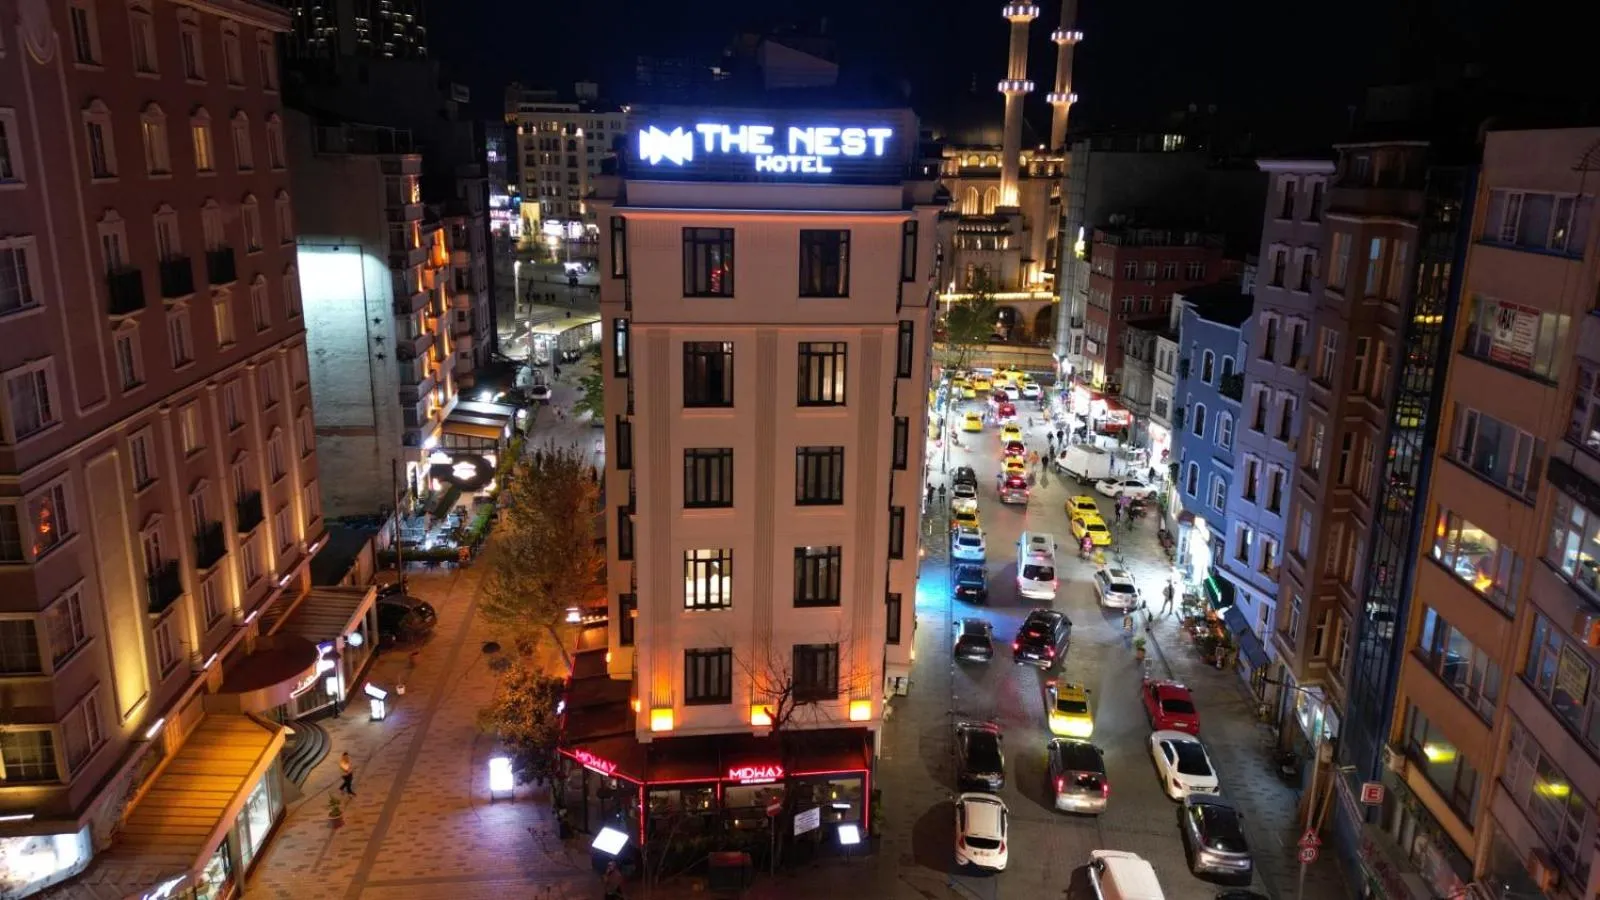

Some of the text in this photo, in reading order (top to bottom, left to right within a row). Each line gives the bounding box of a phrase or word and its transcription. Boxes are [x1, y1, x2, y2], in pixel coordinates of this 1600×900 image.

[696, 123, 893, 156] THE NEST
[755, 155, 832, 173] HOTEL
[729, 765, 784, 780] MIDWAY
